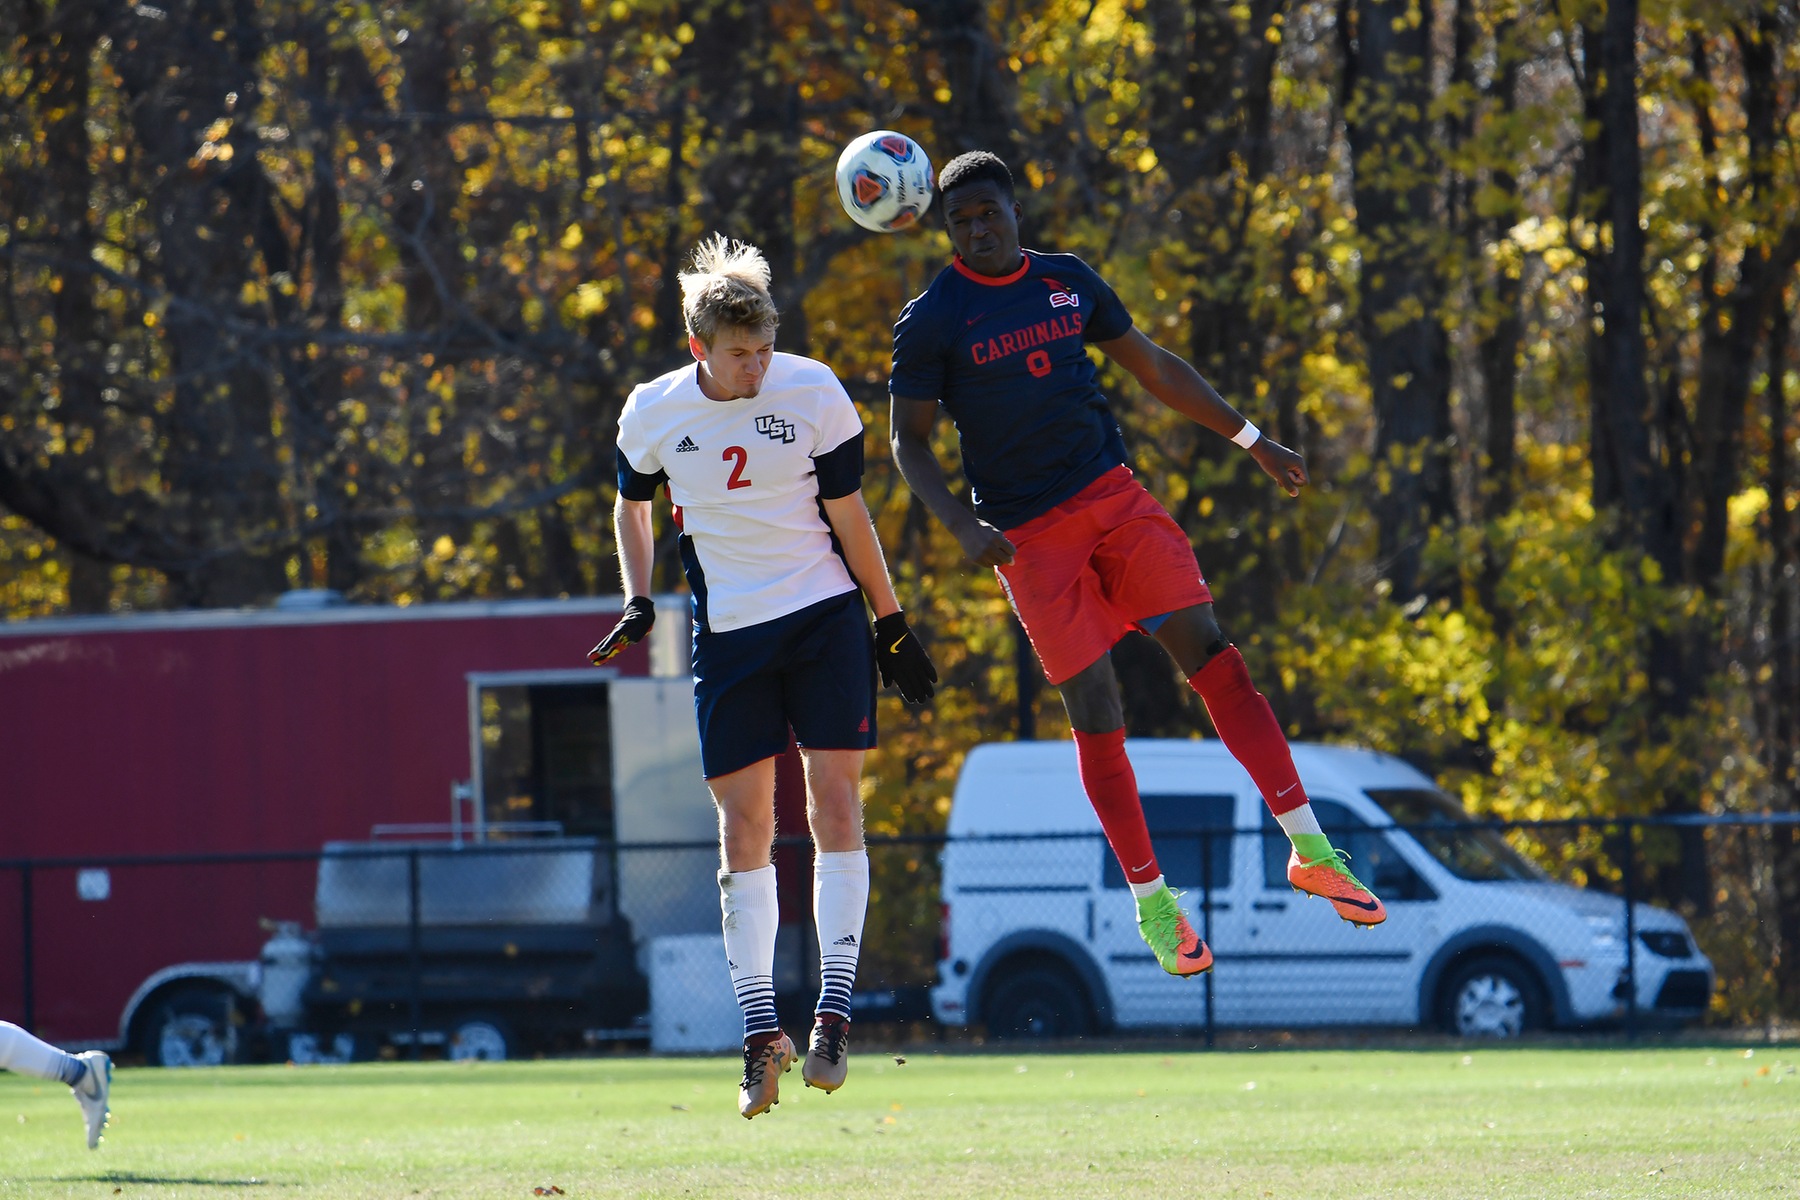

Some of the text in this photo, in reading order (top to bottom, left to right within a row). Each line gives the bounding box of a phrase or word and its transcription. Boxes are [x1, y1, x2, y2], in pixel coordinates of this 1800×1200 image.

[971, 312, 1083, 366] CARDINALS
[754, 414, 796, 445] USI
[675, 445, 700, 453] adidas
[722, 445, 752, 491] 2
